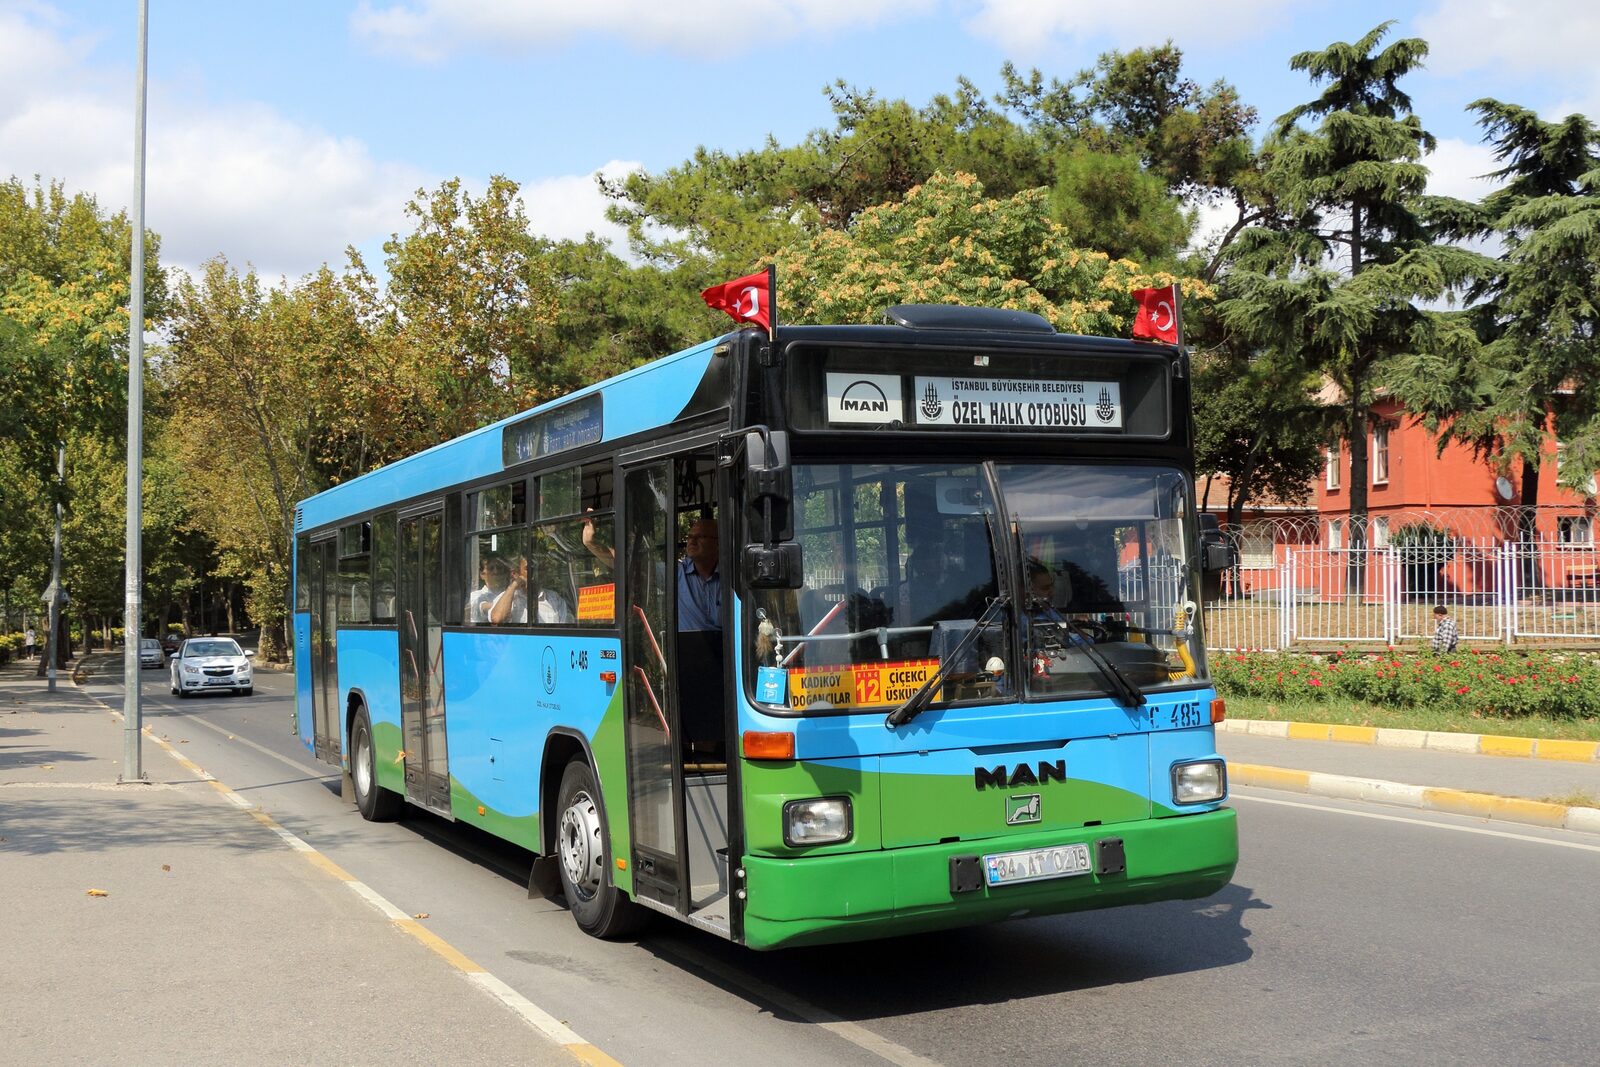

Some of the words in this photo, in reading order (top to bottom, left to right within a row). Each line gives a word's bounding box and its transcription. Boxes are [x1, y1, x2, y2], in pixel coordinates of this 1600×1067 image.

[951, 378, 990, 391] İSTANBUL
[991, 379, 1040, 394] BÜYÜKŞEHİR
[1042, 381, 1085, 394] BELEDİYESİ
[844, 400, 885, 412] MAN
[952, 395, 986, 424] ÖZEL
[990, 402, 1024, 425] HALK
[1027, 397, 1087, 426] OTOBÜSÜ
[801, 672, 841, 689] KADIKÖY
[889, 667, 927, 687] ÇİÇEKCİ
[793, 691, 851, 707] DOĞANCILAR
[857, 679, 880, 702] 12
[1171, 702, 1200, 728] 485
[975, 759, 1067, 791] MAN
[997, 857, 1016, 877] 34
[1053, 847, 1087, 871] 0215
